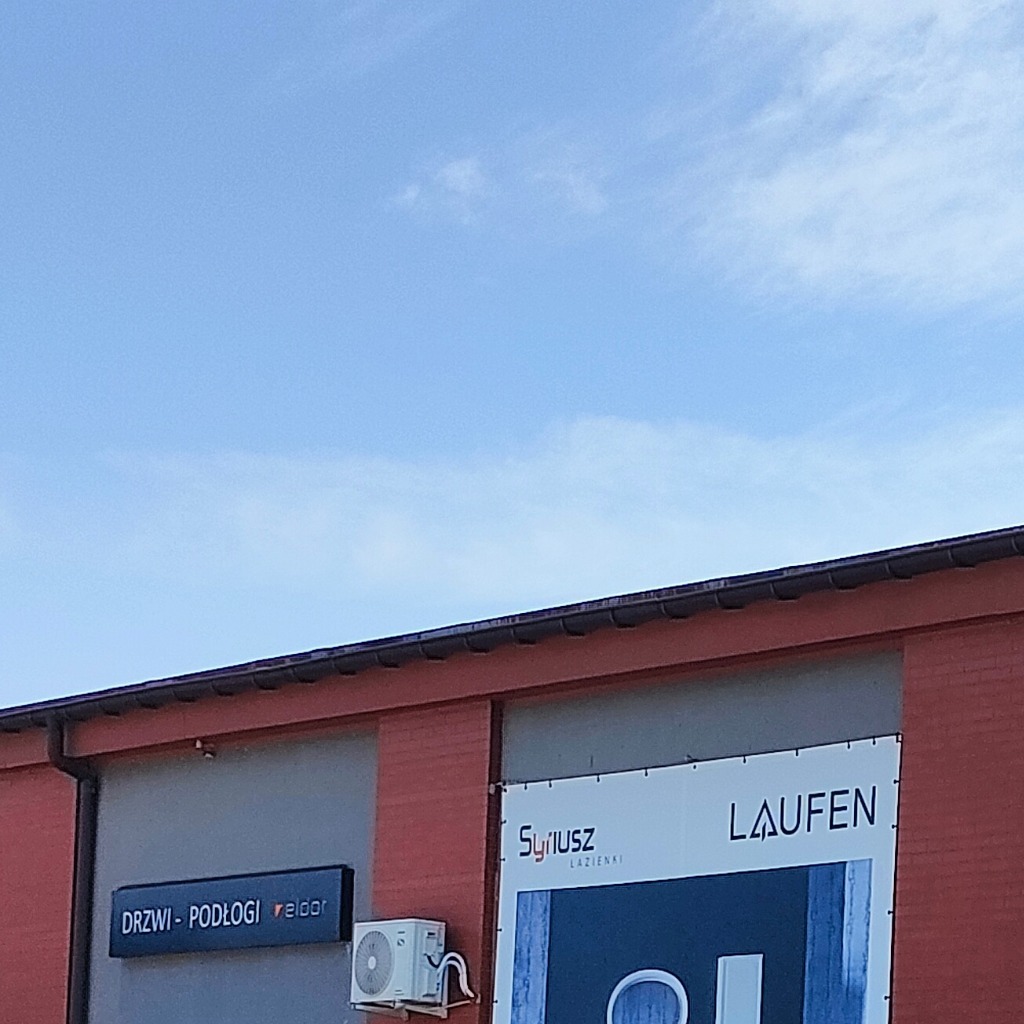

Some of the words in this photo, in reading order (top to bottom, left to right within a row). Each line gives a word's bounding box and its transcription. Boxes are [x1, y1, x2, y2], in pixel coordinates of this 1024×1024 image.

[729, 785, 877, 841] LAUFEN
[121, 907, 172, 935] DRZWI
[189, 900, 261, 929] PODŁOGI
